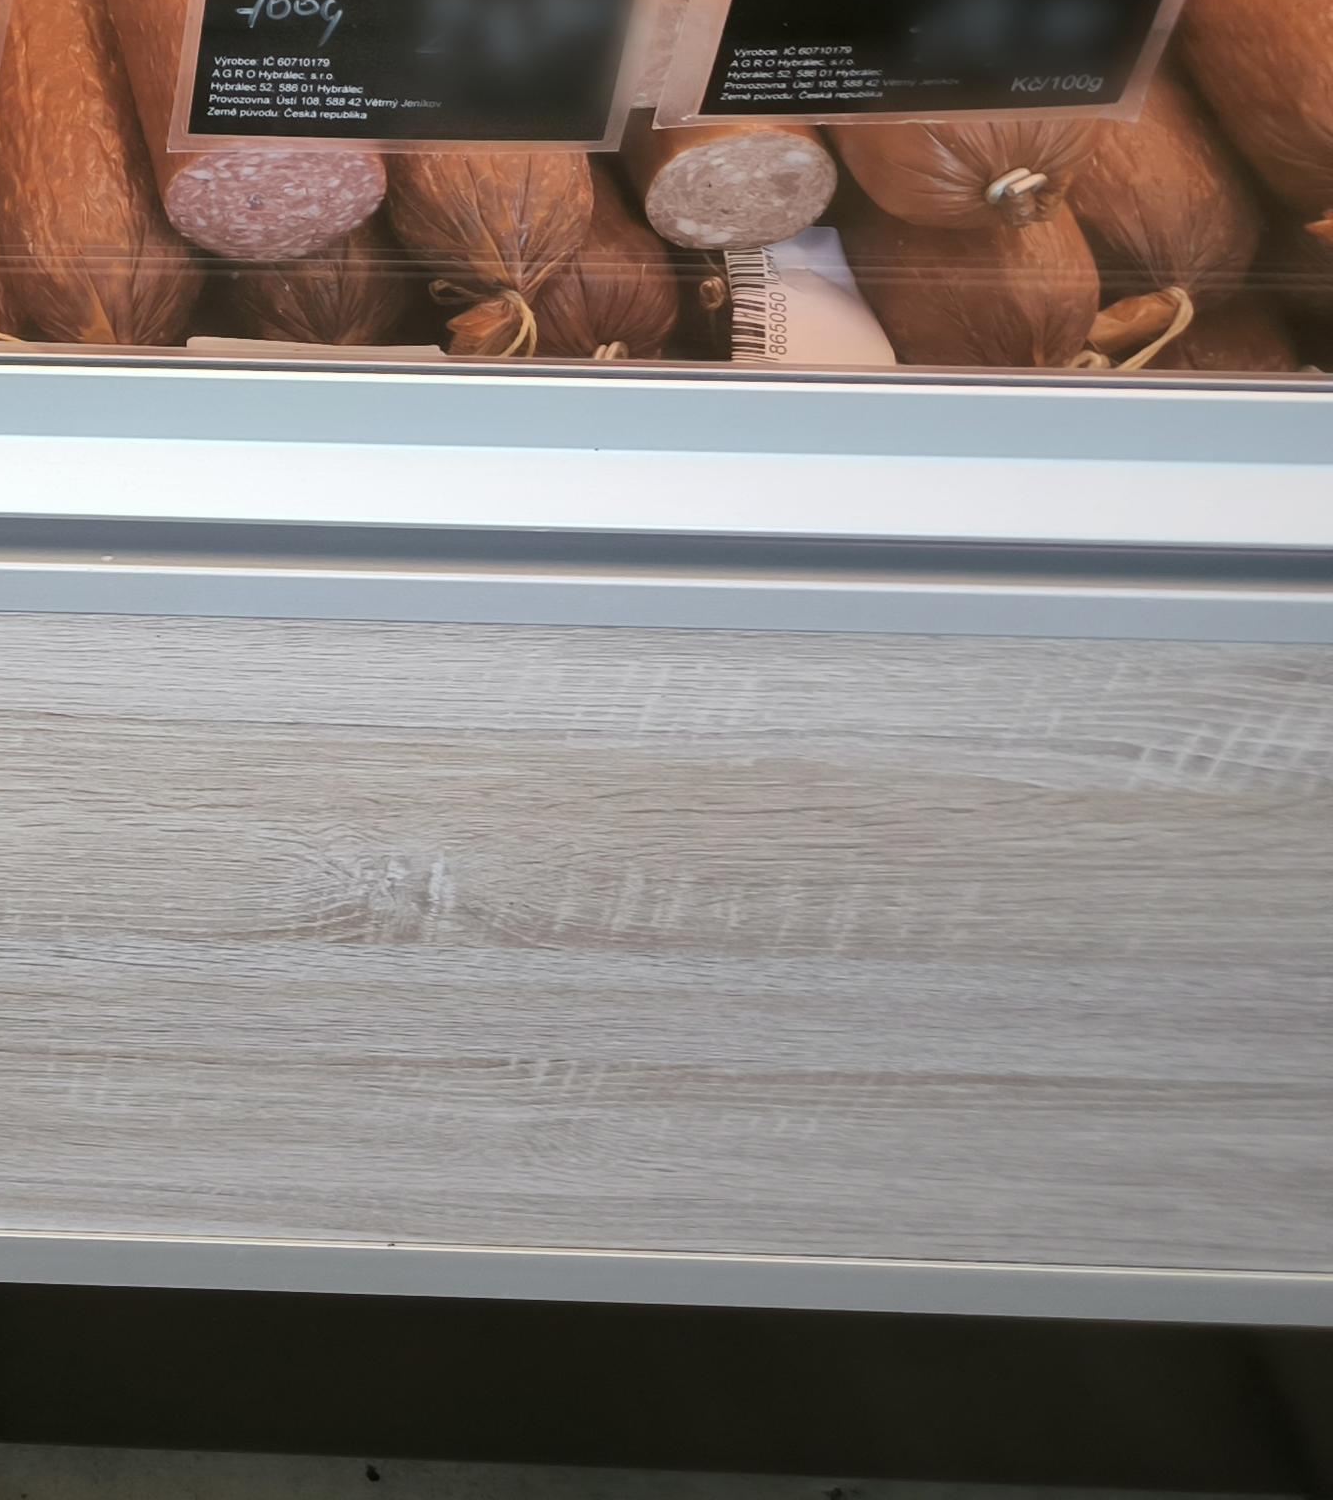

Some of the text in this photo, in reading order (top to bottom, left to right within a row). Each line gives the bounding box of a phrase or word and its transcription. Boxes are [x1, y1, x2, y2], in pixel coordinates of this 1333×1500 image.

[263, 56, 274, 66] IČ
[277, 58, 331, 67] 60710179
[301, 84, 313, 93] 01
[1009, 73, 1105, 96] Kč/100g
[276, 94, 297, 105] Ústí
[348, 97, 361, 107] 42
[207, 107, 237, 117] Země
[284, 108, 317, 118] Česká
[320, 110, 367, 120] republika
[768, 292, 787, 356] 865050
